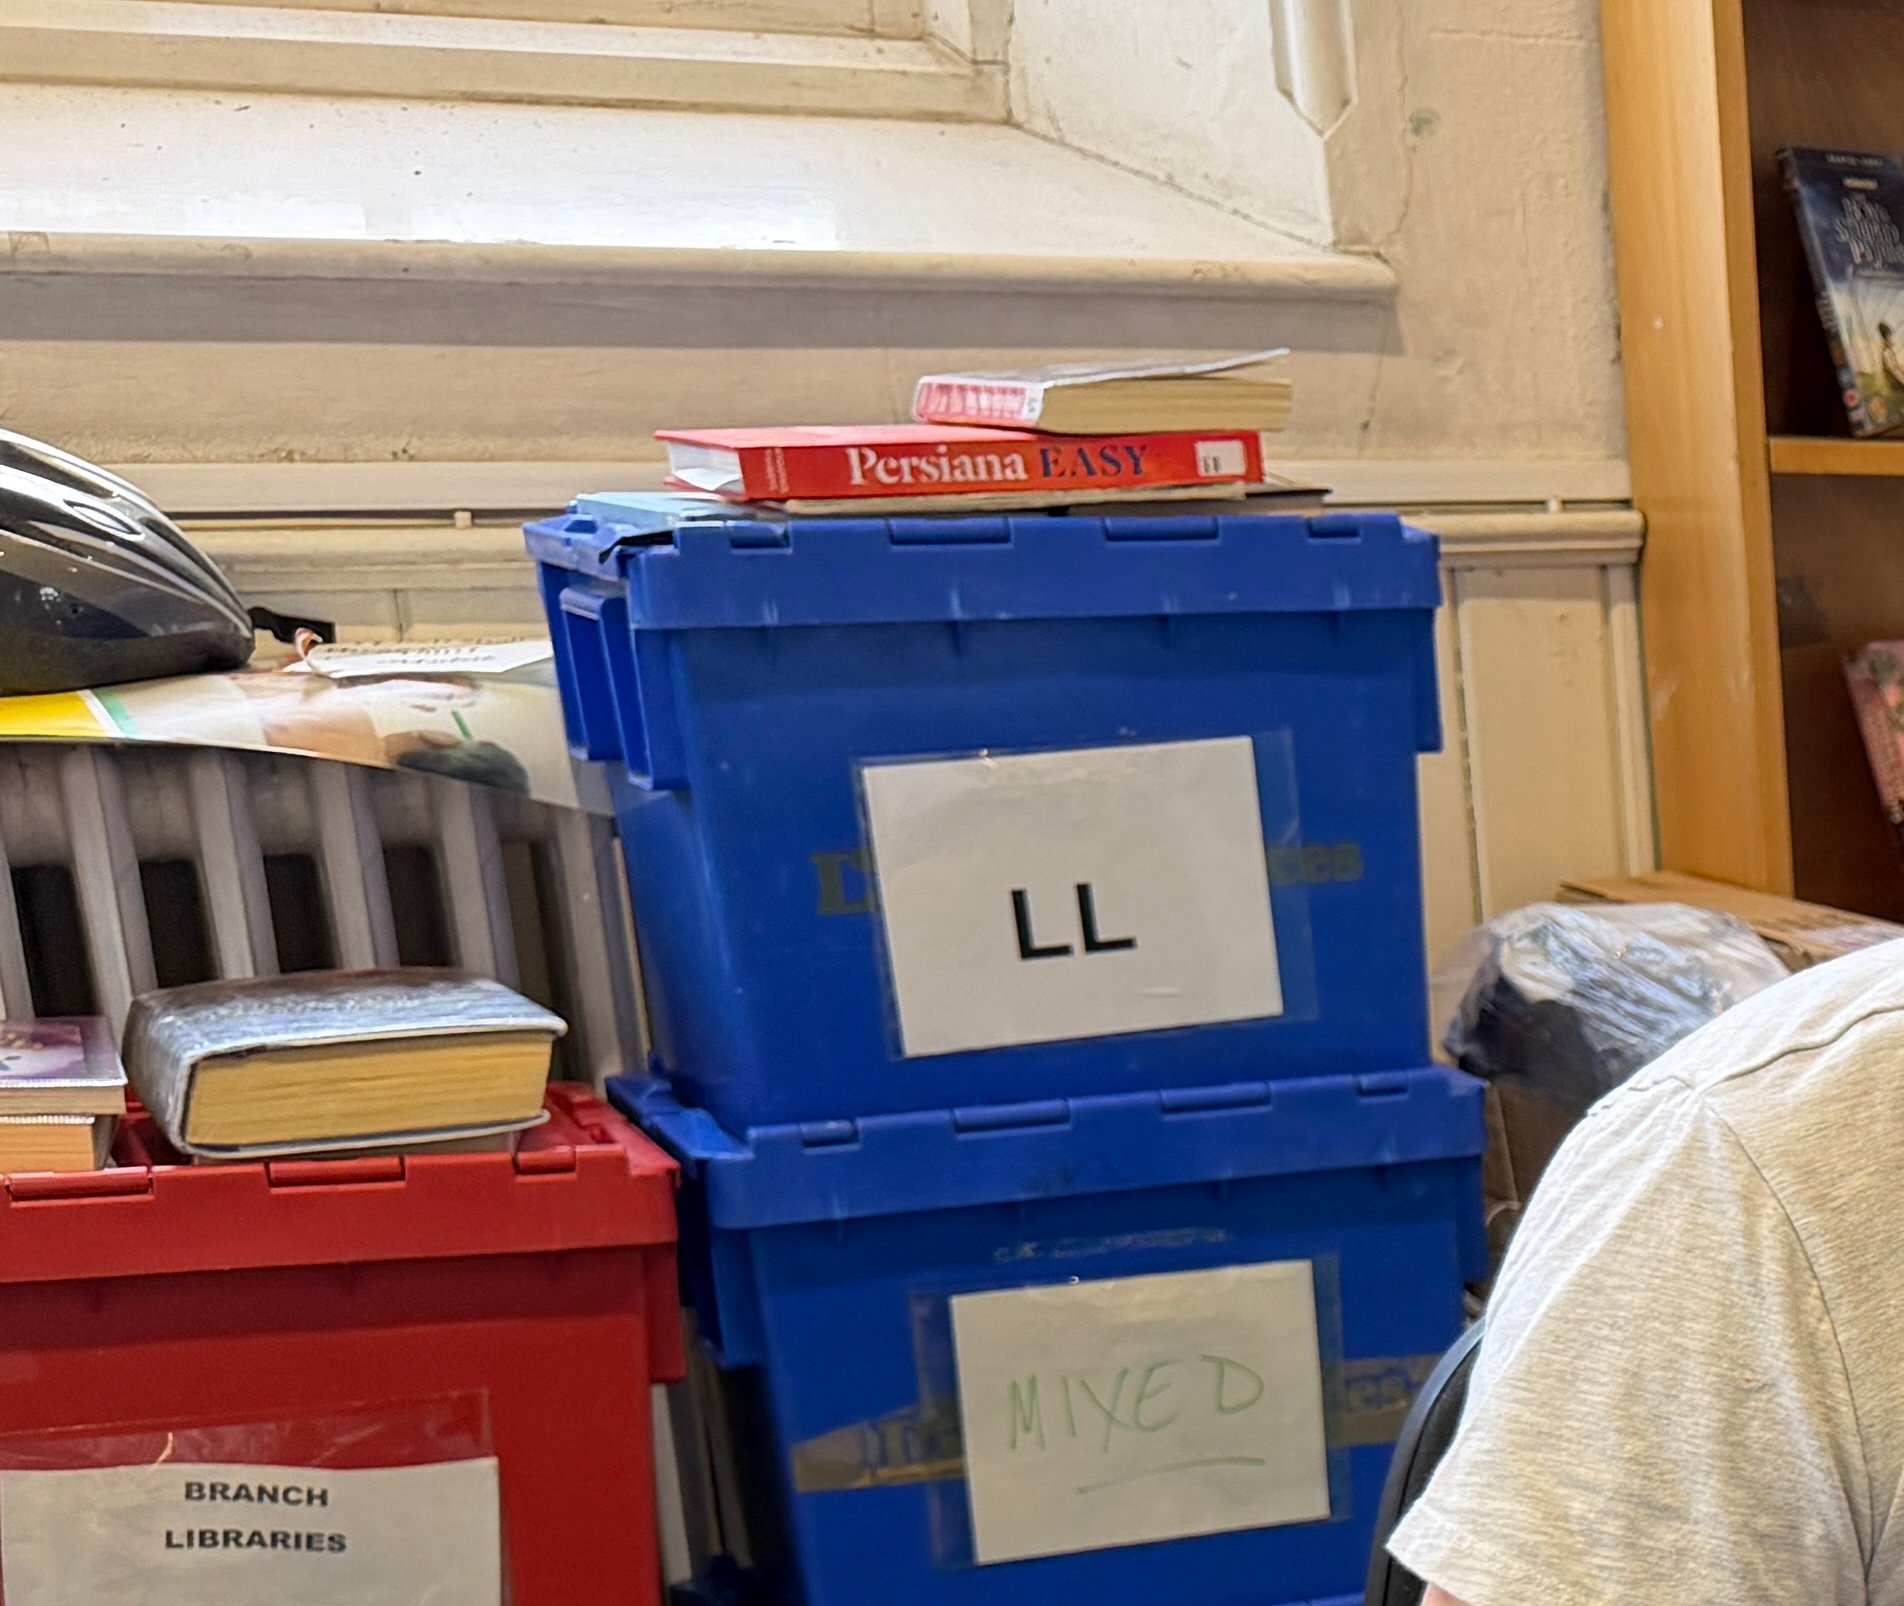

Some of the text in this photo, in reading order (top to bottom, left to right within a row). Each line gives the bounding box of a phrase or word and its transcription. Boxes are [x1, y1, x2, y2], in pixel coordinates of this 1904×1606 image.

[846, 445, 1149, 485] Persiana EASY
[1011, 882, 1137, 960] LL
[1008, 1355, 1265, 1453] MIXED
[183, 1481, 330, 1508] BRANCH
[164, 1529, 348, 1554] LIBRARIES
